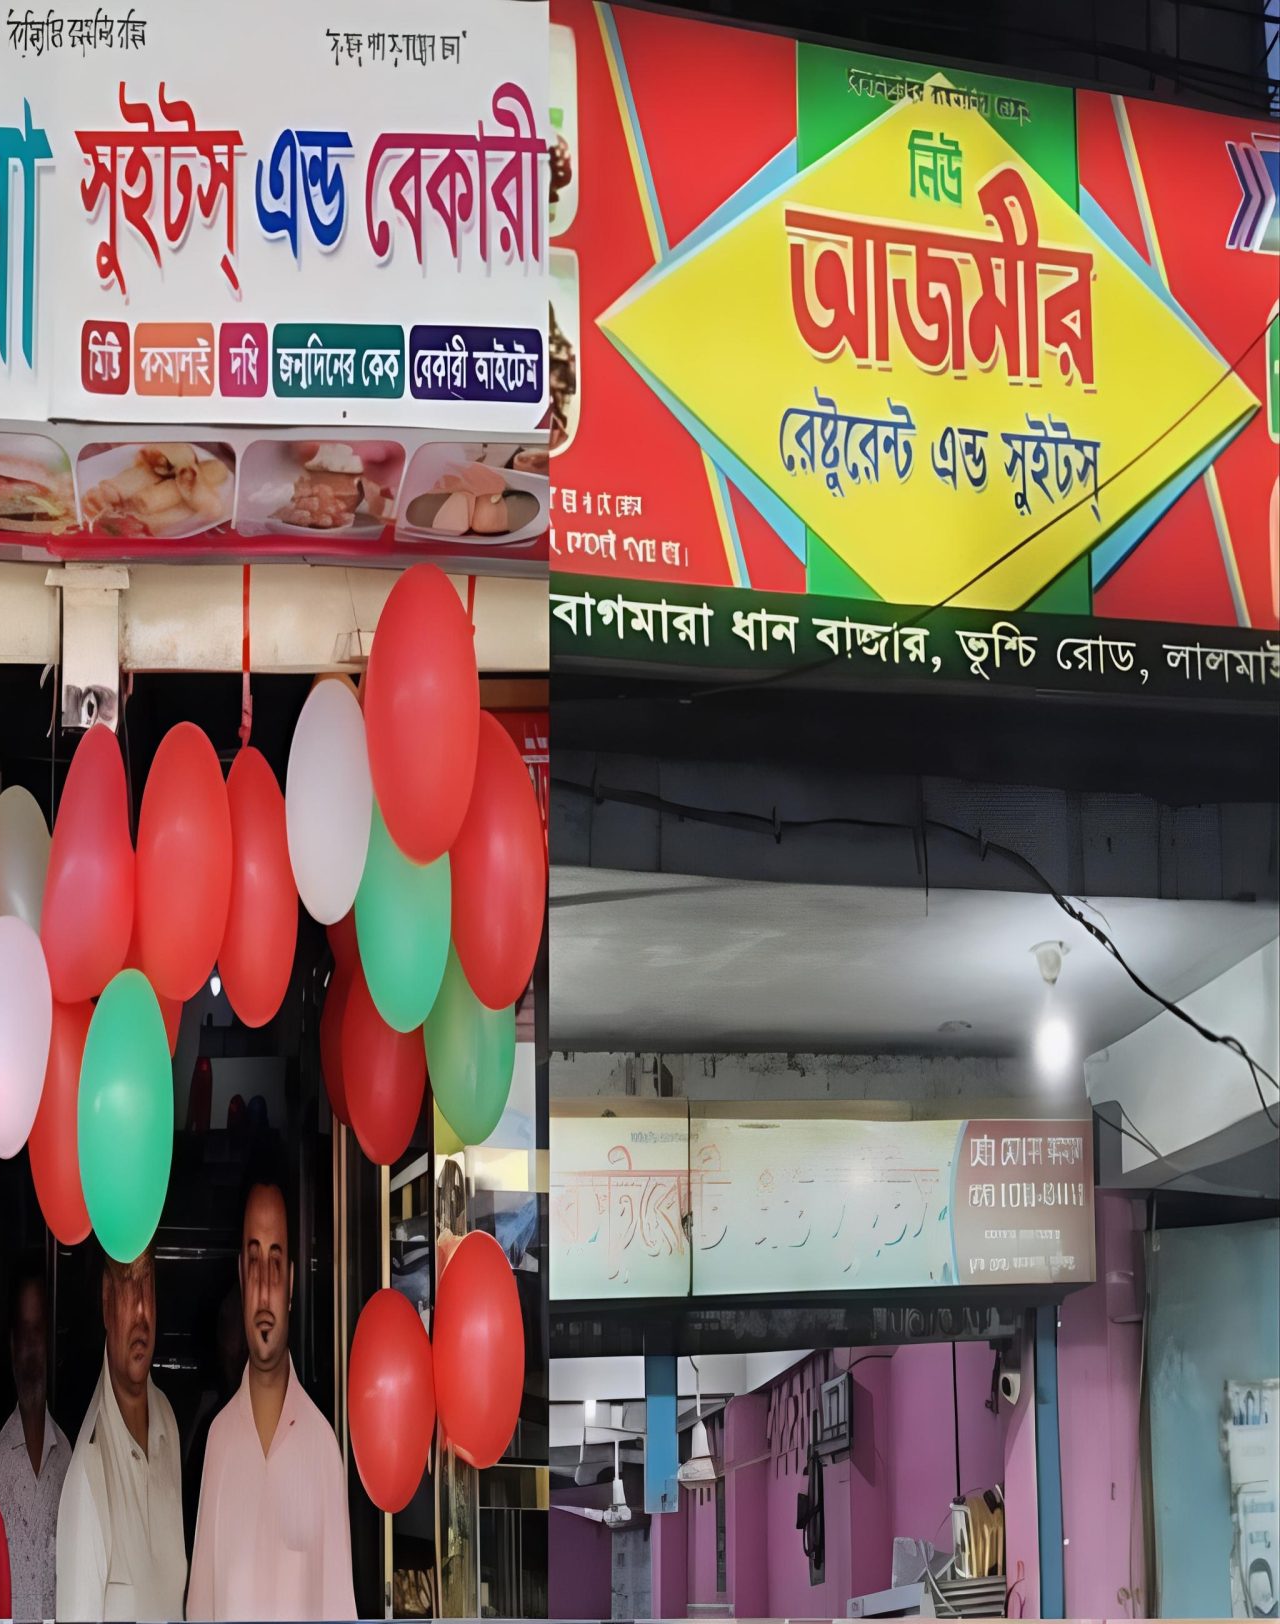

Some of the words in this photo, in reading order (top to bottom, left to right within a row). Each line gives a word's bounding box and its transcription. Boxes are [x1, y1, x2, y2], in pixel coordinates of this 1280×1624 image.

[75, 82, 244, 295] সুইটস্
[256, 129, 353, 257] এন্ড
[366, 83, 547, 265] বেকারী
[907, 130, 963, 206] নিউ
[785, 166, 1098, 392] আজমীর
[931, 427, 988, 491] এন্ড
[1001, 413, 1101, 522] সুইটস্
[552, 592, 714, 647] বাগমারা
[732, 607, 799, 654] ধান
[812, 617, 941, 673] বাজার,
[1056, 635, 1149, 685] রোড,
